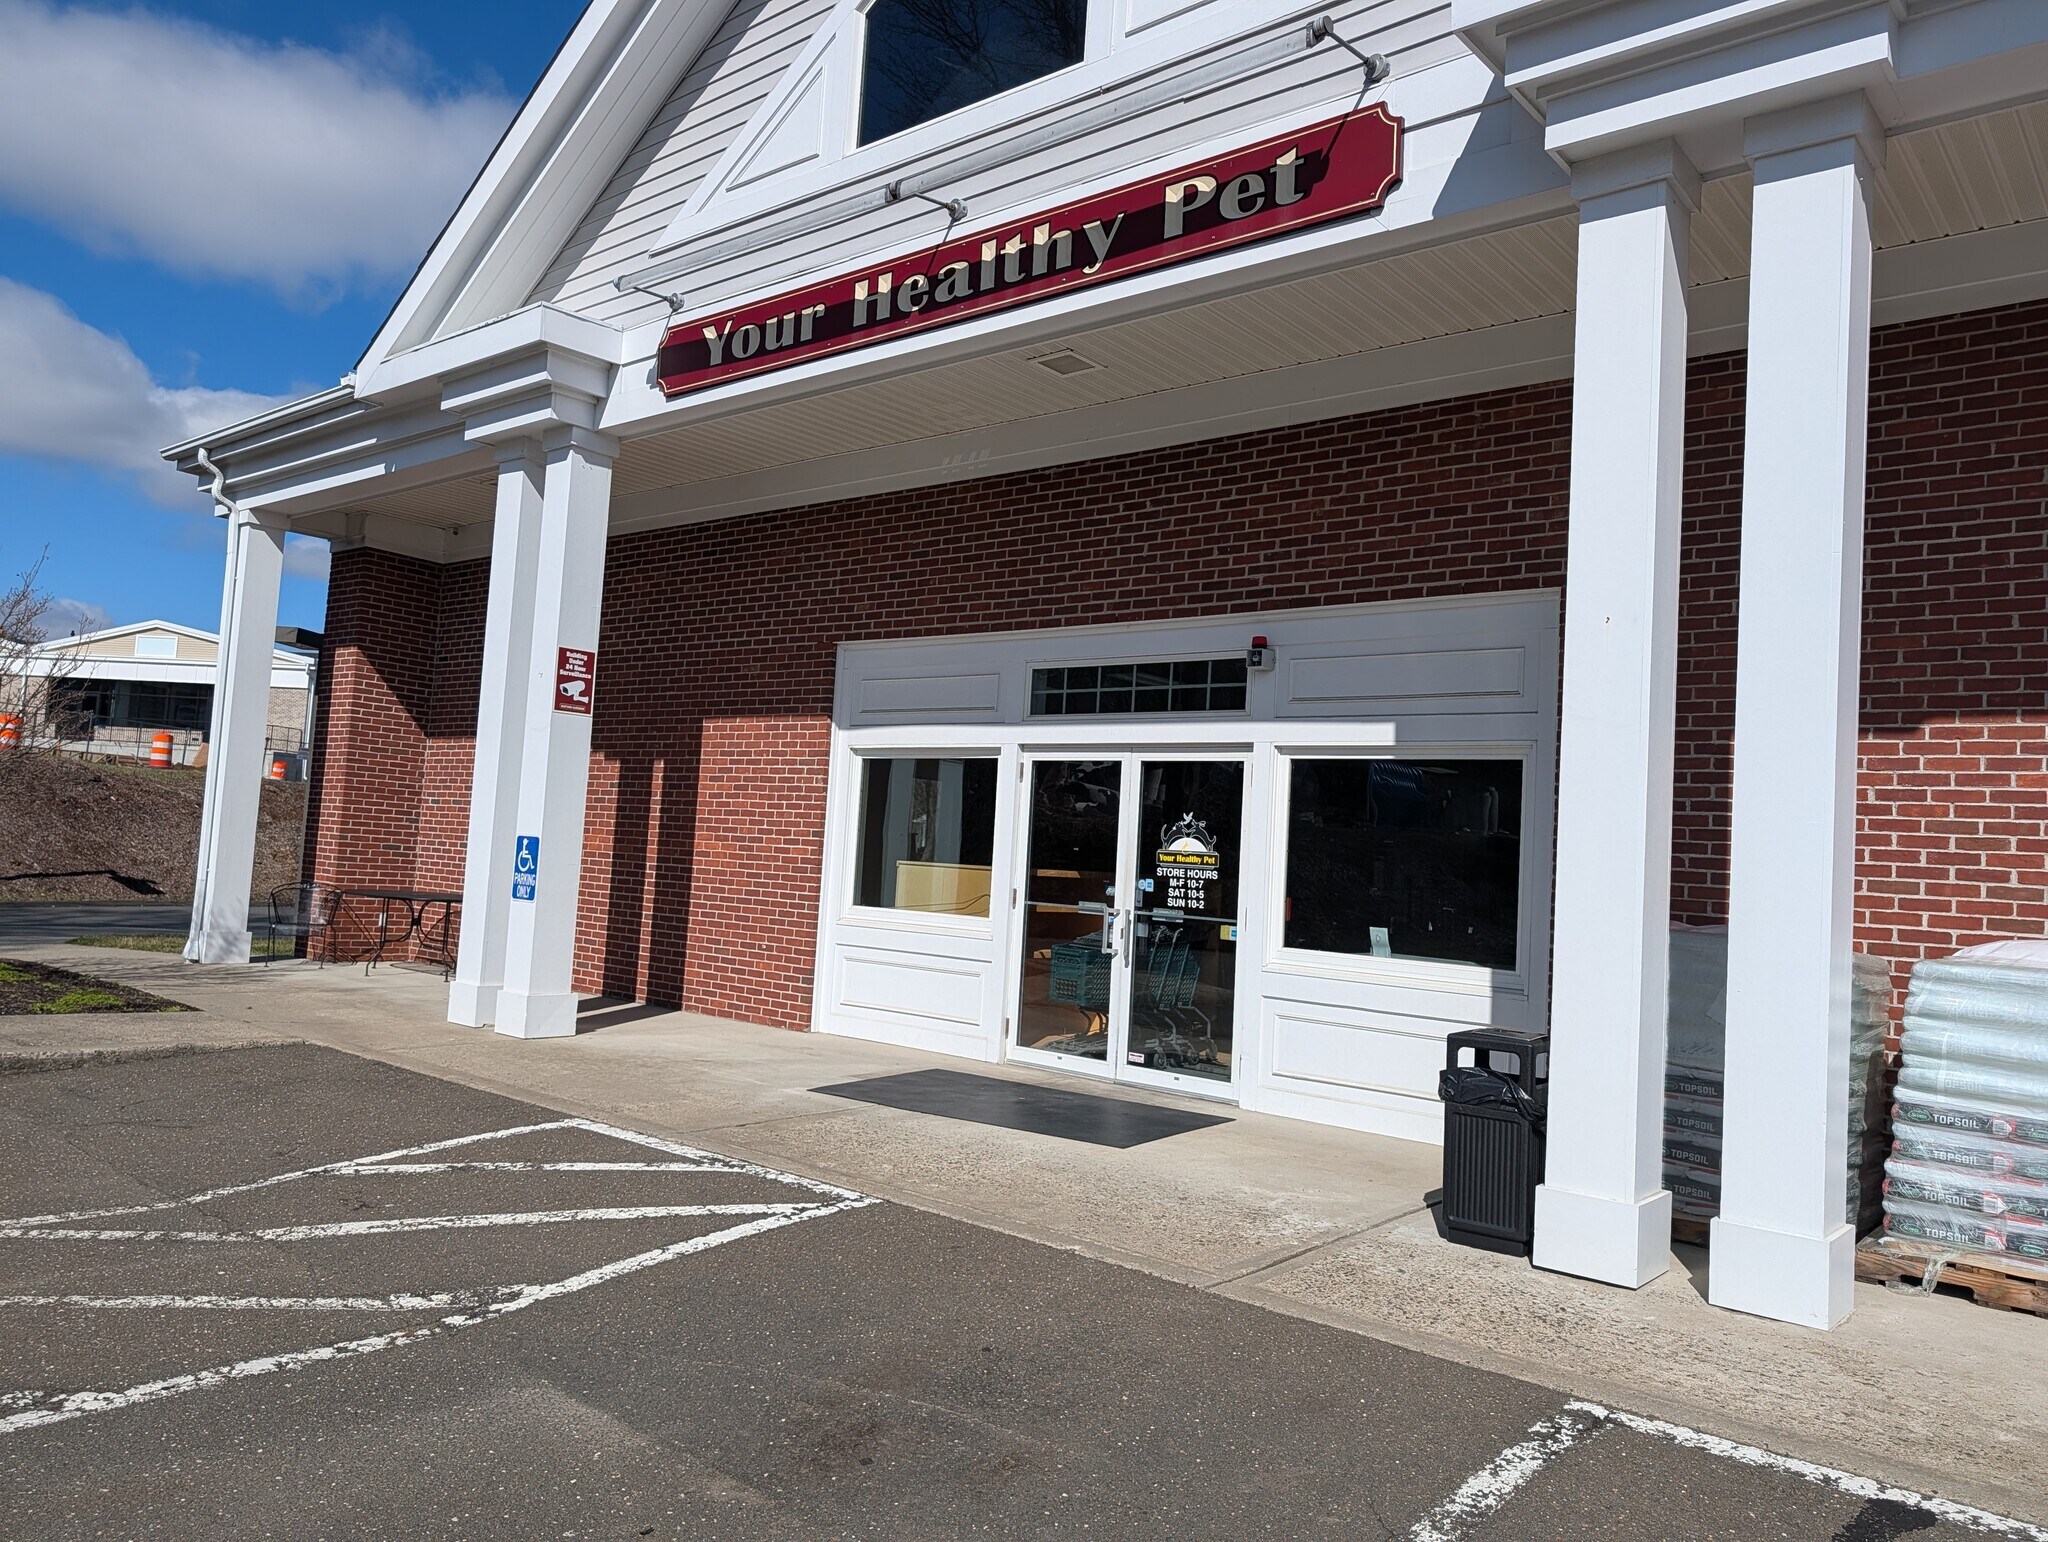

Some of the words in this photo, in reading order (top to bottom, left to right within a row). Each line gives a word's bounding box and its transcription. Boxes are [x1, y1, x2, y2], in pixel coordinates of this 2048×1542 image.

[703, 306, 825, 367] Your
[852, 212, 1126, 329] Healthy
[1163, 145, 1305, 240] Pet
[566, 651, 587, 660] Building
[560, 669, 592, 679] Surveillance
[1159, 854, 1175, 862] Your
[1176, 854, 1202, 865] Healthy
[1203, 856, 1216, 864] Pet
[514, 872, 535, 886] PARKING
[1156, 867, 1186, 878] STORE
[1187, 869, 1219, 880] HOURS
[1169, 878, 1185, 888] M-F
[1186, 879, 1204, 889] 10-7
[516, 885, 531, 898] ONLY
[1168, 887, 1186, 898] SAT
[1187, 888, 1205, 899] 10-5
[1167, 897, 1186, 908] SUN
[1187, 898, 1205, 909] 10-2
[1679, 1082, 1718, 1096] TOPSOIL
[1676, 1116, 1715, 1132] TOPSOIL
[1933, 1113, 1980, 1129] TOPSOIL
[1670, 1149, 1709, 1165] TOPSOIL
[1932, 1150, 1980, 1166] TOPSOIL
[1673, 1184, 1712, 1200] TOPSOIL
[1922, 1189, 1970, 1207] TOPSOIL
[1924, 1227, 1972, 1244] TOPSOIL
